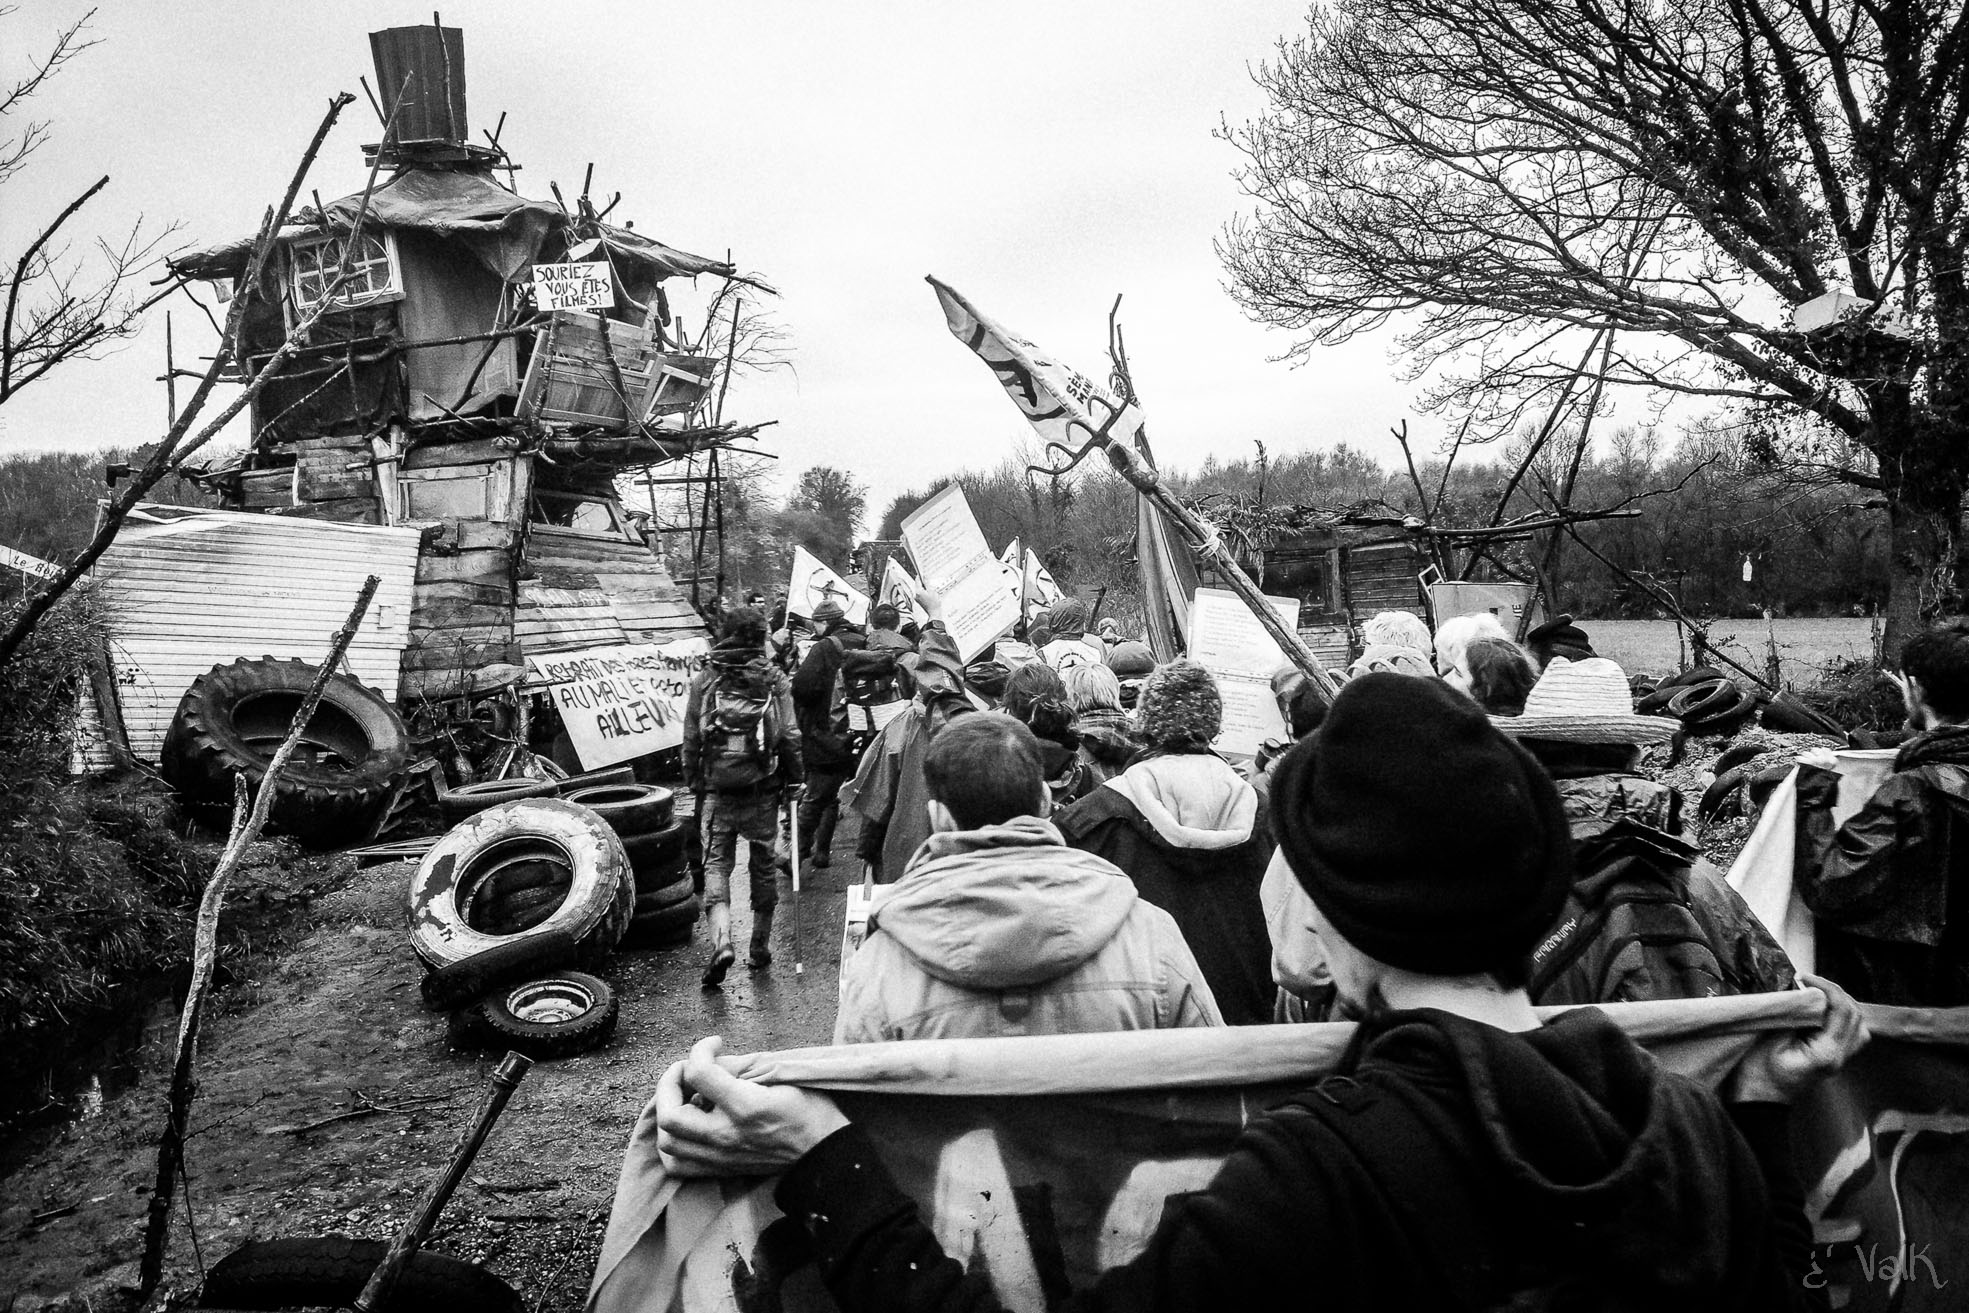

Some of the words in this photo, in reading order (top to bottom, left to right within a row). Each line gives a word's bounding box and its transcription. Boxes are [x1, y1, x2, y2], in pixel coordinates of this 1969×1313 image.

[536, 264, 595, 282] SOURIEZ
[545, 281, 577, 296] VOUS
[560, 685, 591, 708] AU
